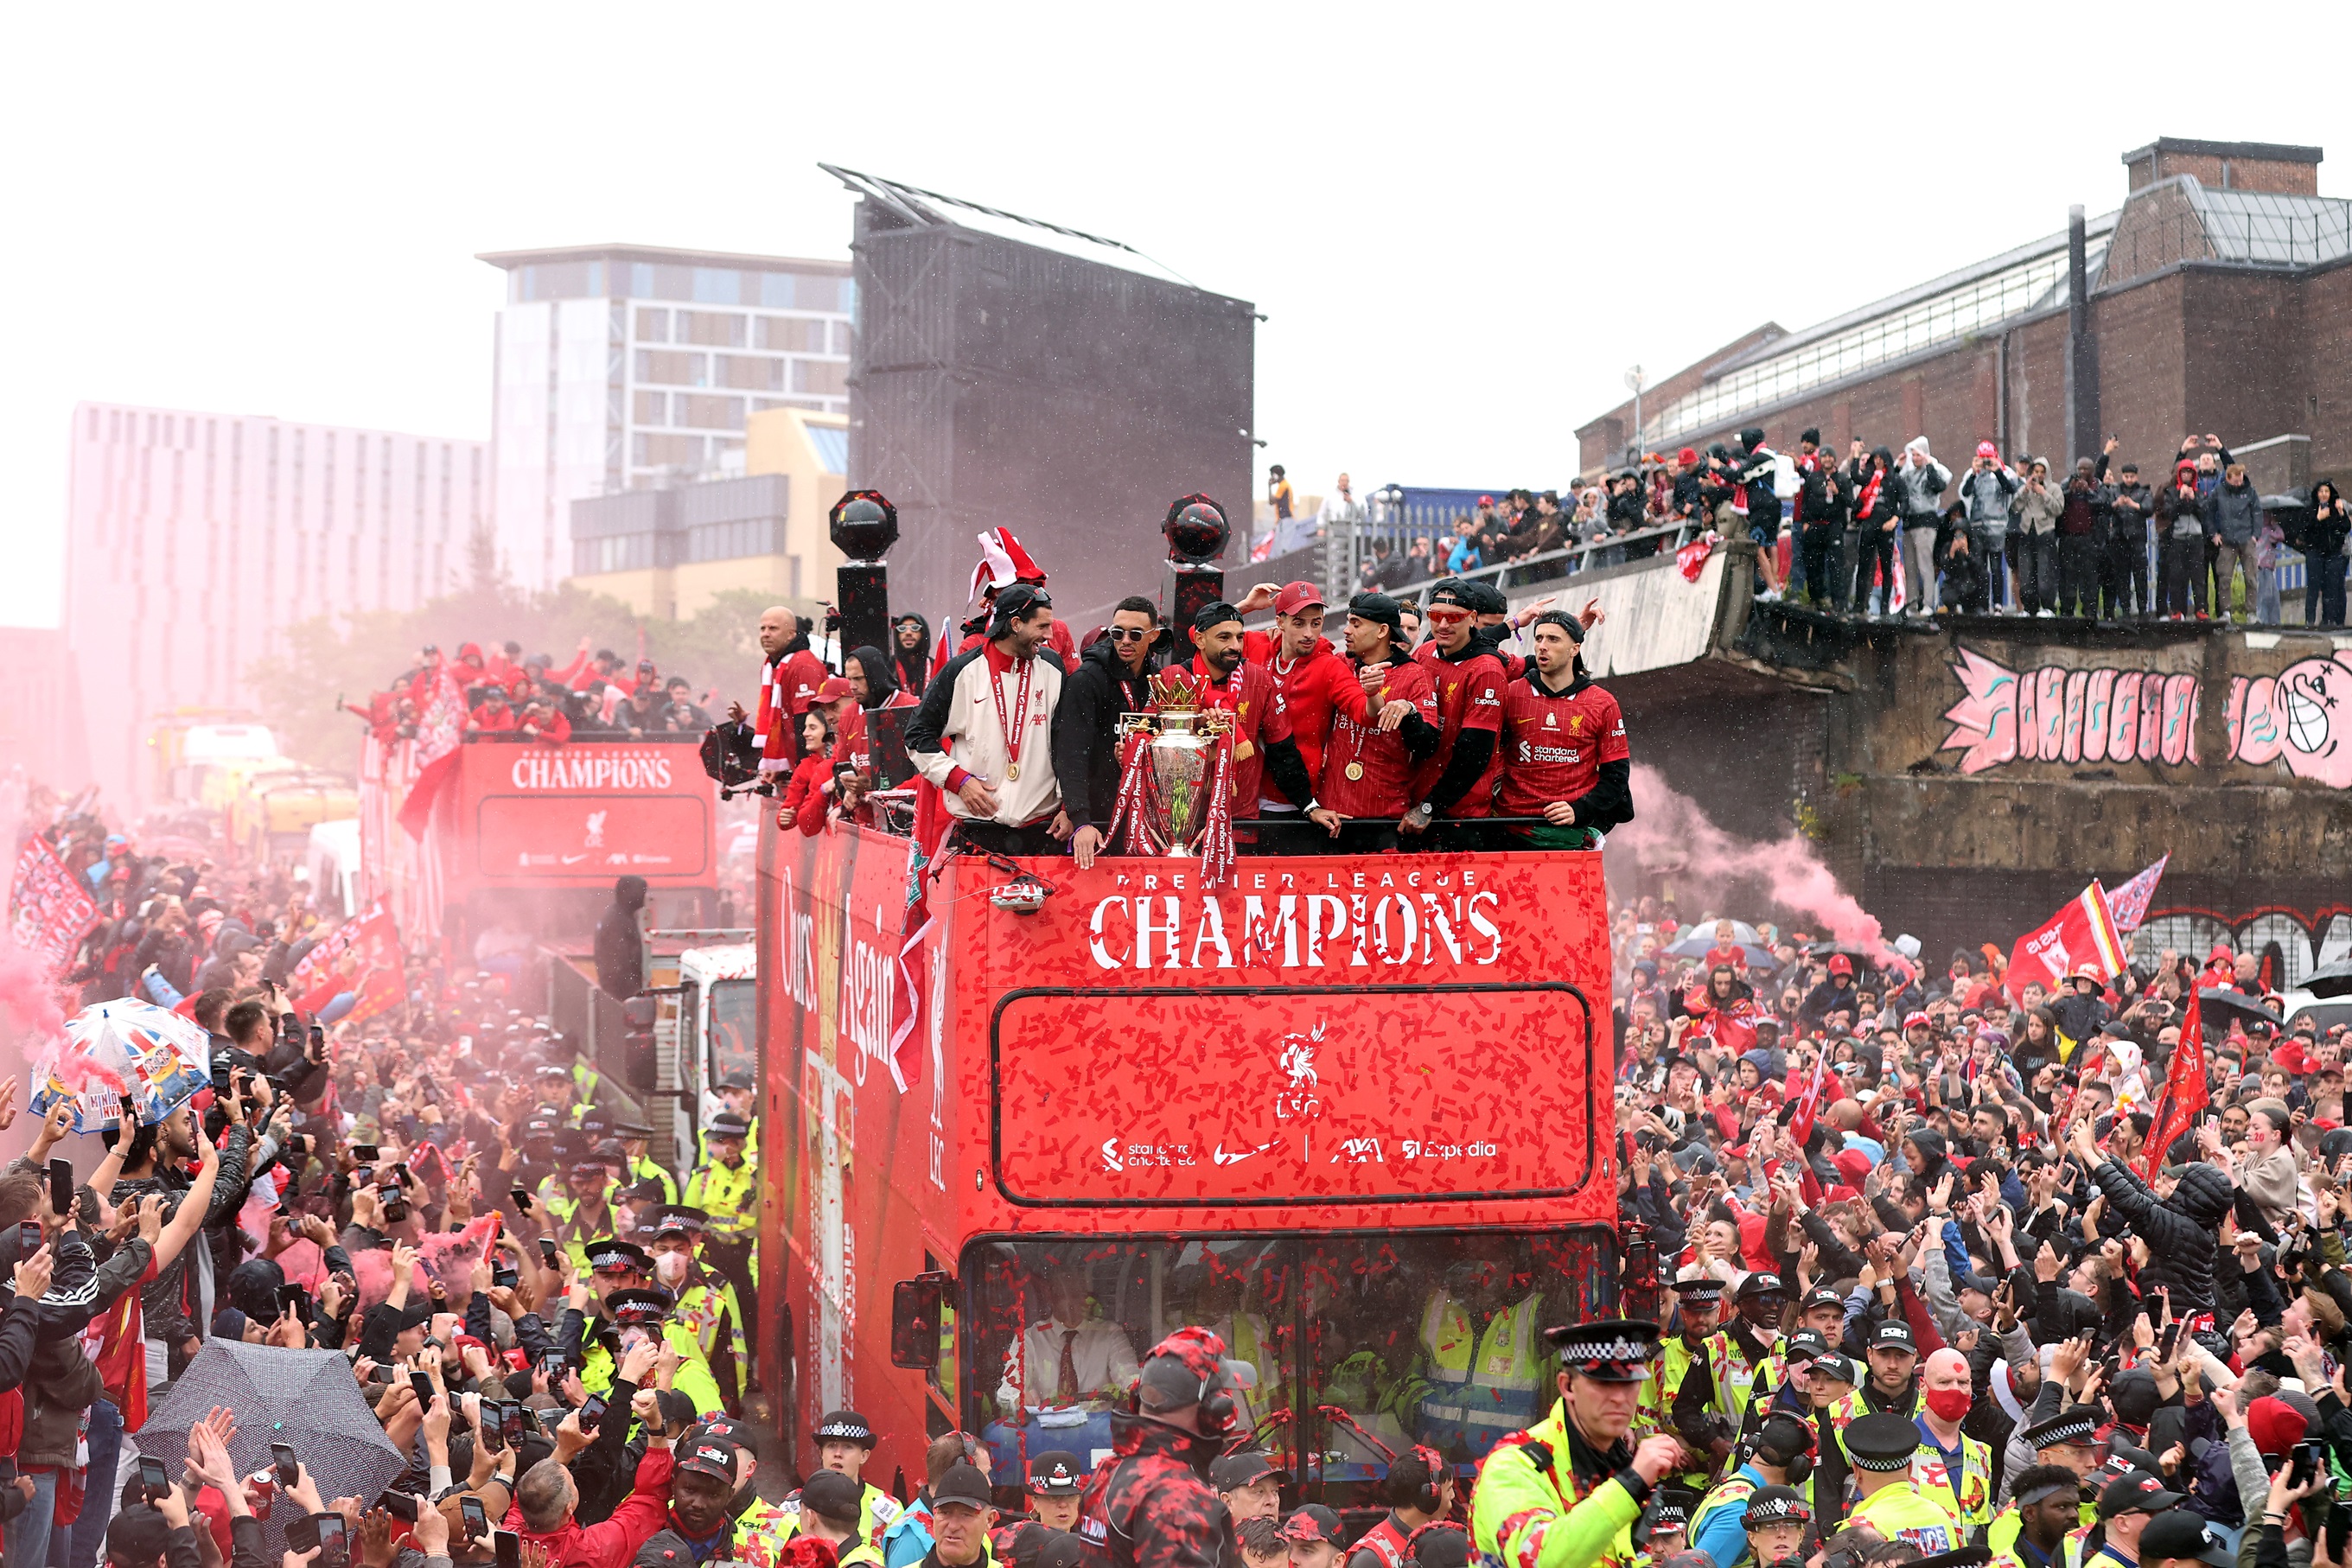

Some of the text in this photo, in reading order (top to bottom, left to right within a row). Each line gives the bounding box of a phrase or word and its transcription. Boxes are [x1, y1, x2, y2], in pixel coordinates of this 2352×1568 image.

[1475, 698, 1501, 707] Expedia
[1012, 704, 1024, 744] Premier League
[1029, 714, 1048, 727] AXA
[1354, 737, 1363, 757] Premier
[1533, 754, 1580, 763] chartered
[1534, 745, 1578, 756] standard
[511, 757, 672, 789] CHAMPIONS
[1120, 738, 1146, 796] Premier League
[1212, 748, 1227, 806] Premier League
[1108, 807, 1122, 836] League
[1129, 810, 1138, 839] League
[1200, 819, 1214, 877] Premier League
[1217, 822, 1227, 883] Premier League
[1117, 870, 1476, 889] PREMIER LEAGUE
[1089, 891, 1502, 971] CHAMPIONS
[1329, 1138, 1384, 1163] AXA
[2253, 1132, 2266, 1143] 20
